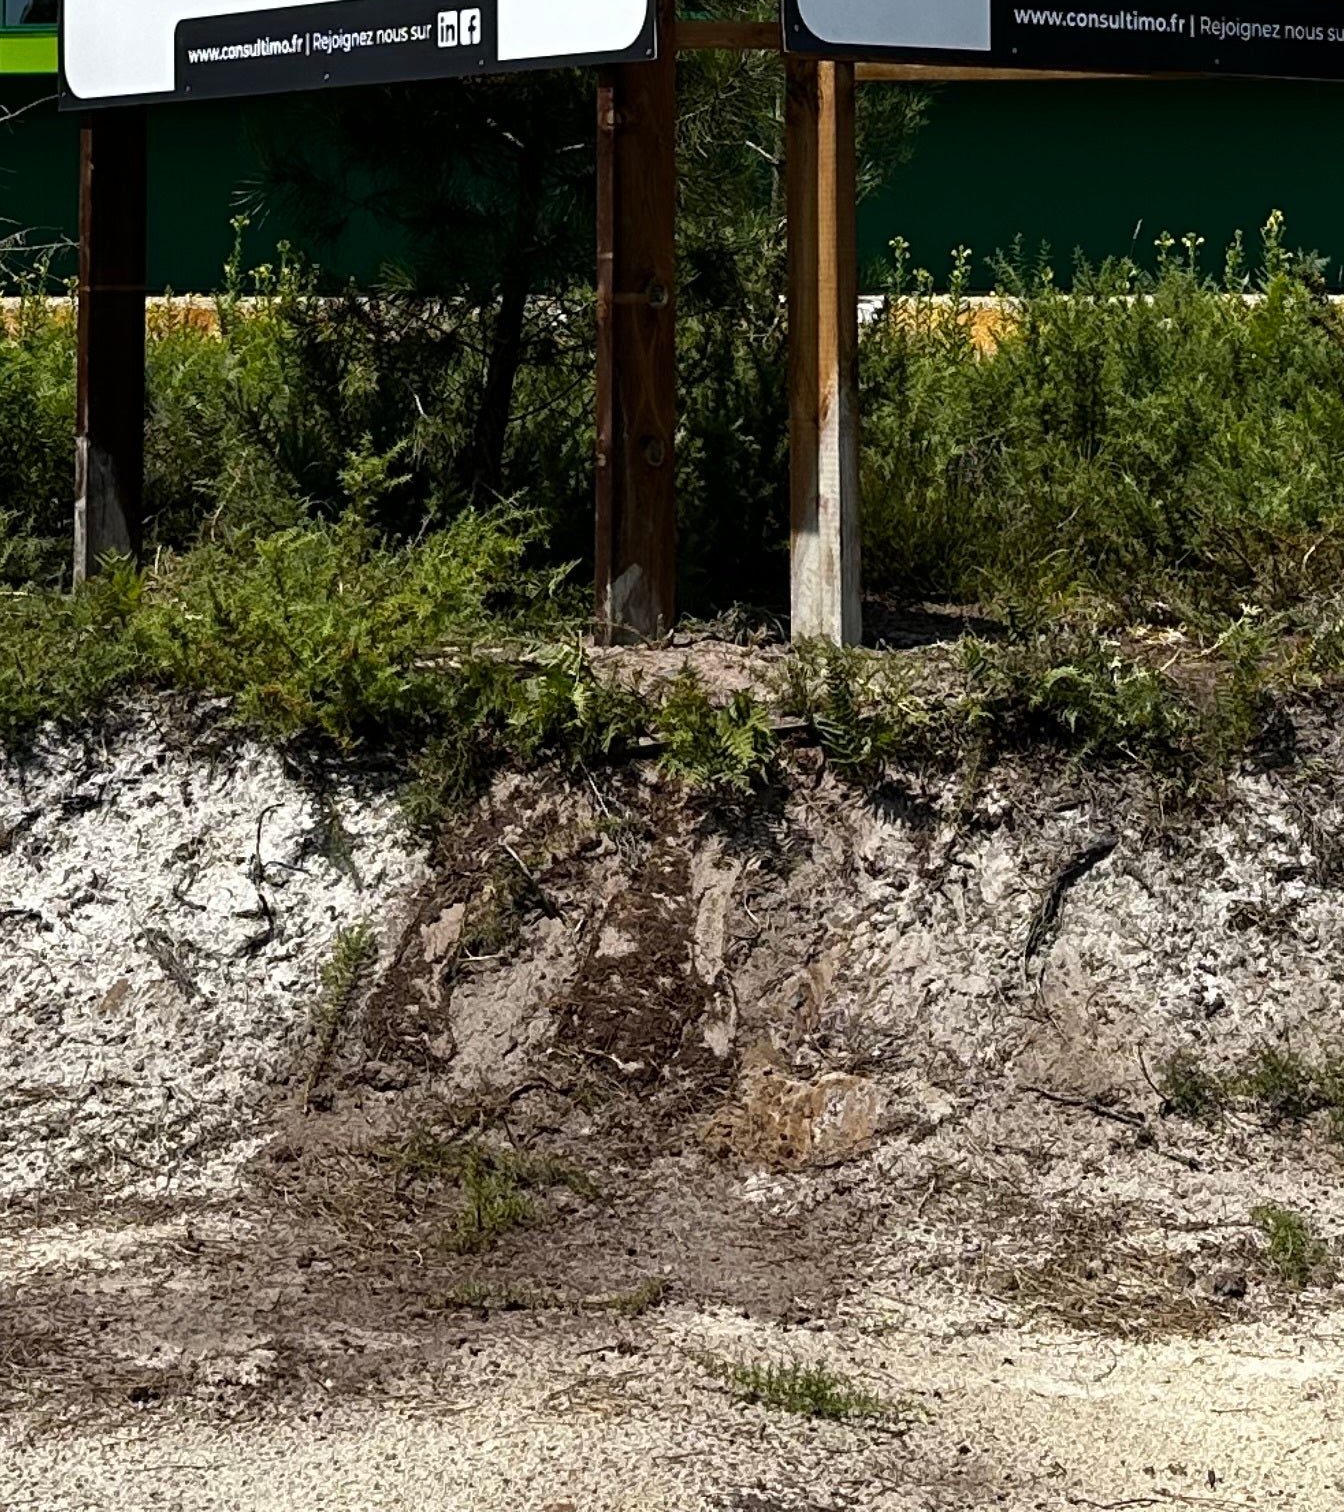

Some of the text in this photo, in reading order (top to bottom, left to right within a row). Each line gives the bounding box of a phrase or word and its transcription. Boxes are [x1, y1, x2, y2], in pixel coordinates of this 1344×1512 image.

[187, 34, 304, 64] www.consultimo.fr
[313, 30, 373, 54] Rejoignez
[376, 27, 408, 45] nous
[411, 23, 431, 41] sur
[1014, 8, 1185, 34] www.consultimo.fr
[1200, 17, 1280, 42] Rejoignez
[1284, 24, 1324, 41] nous
